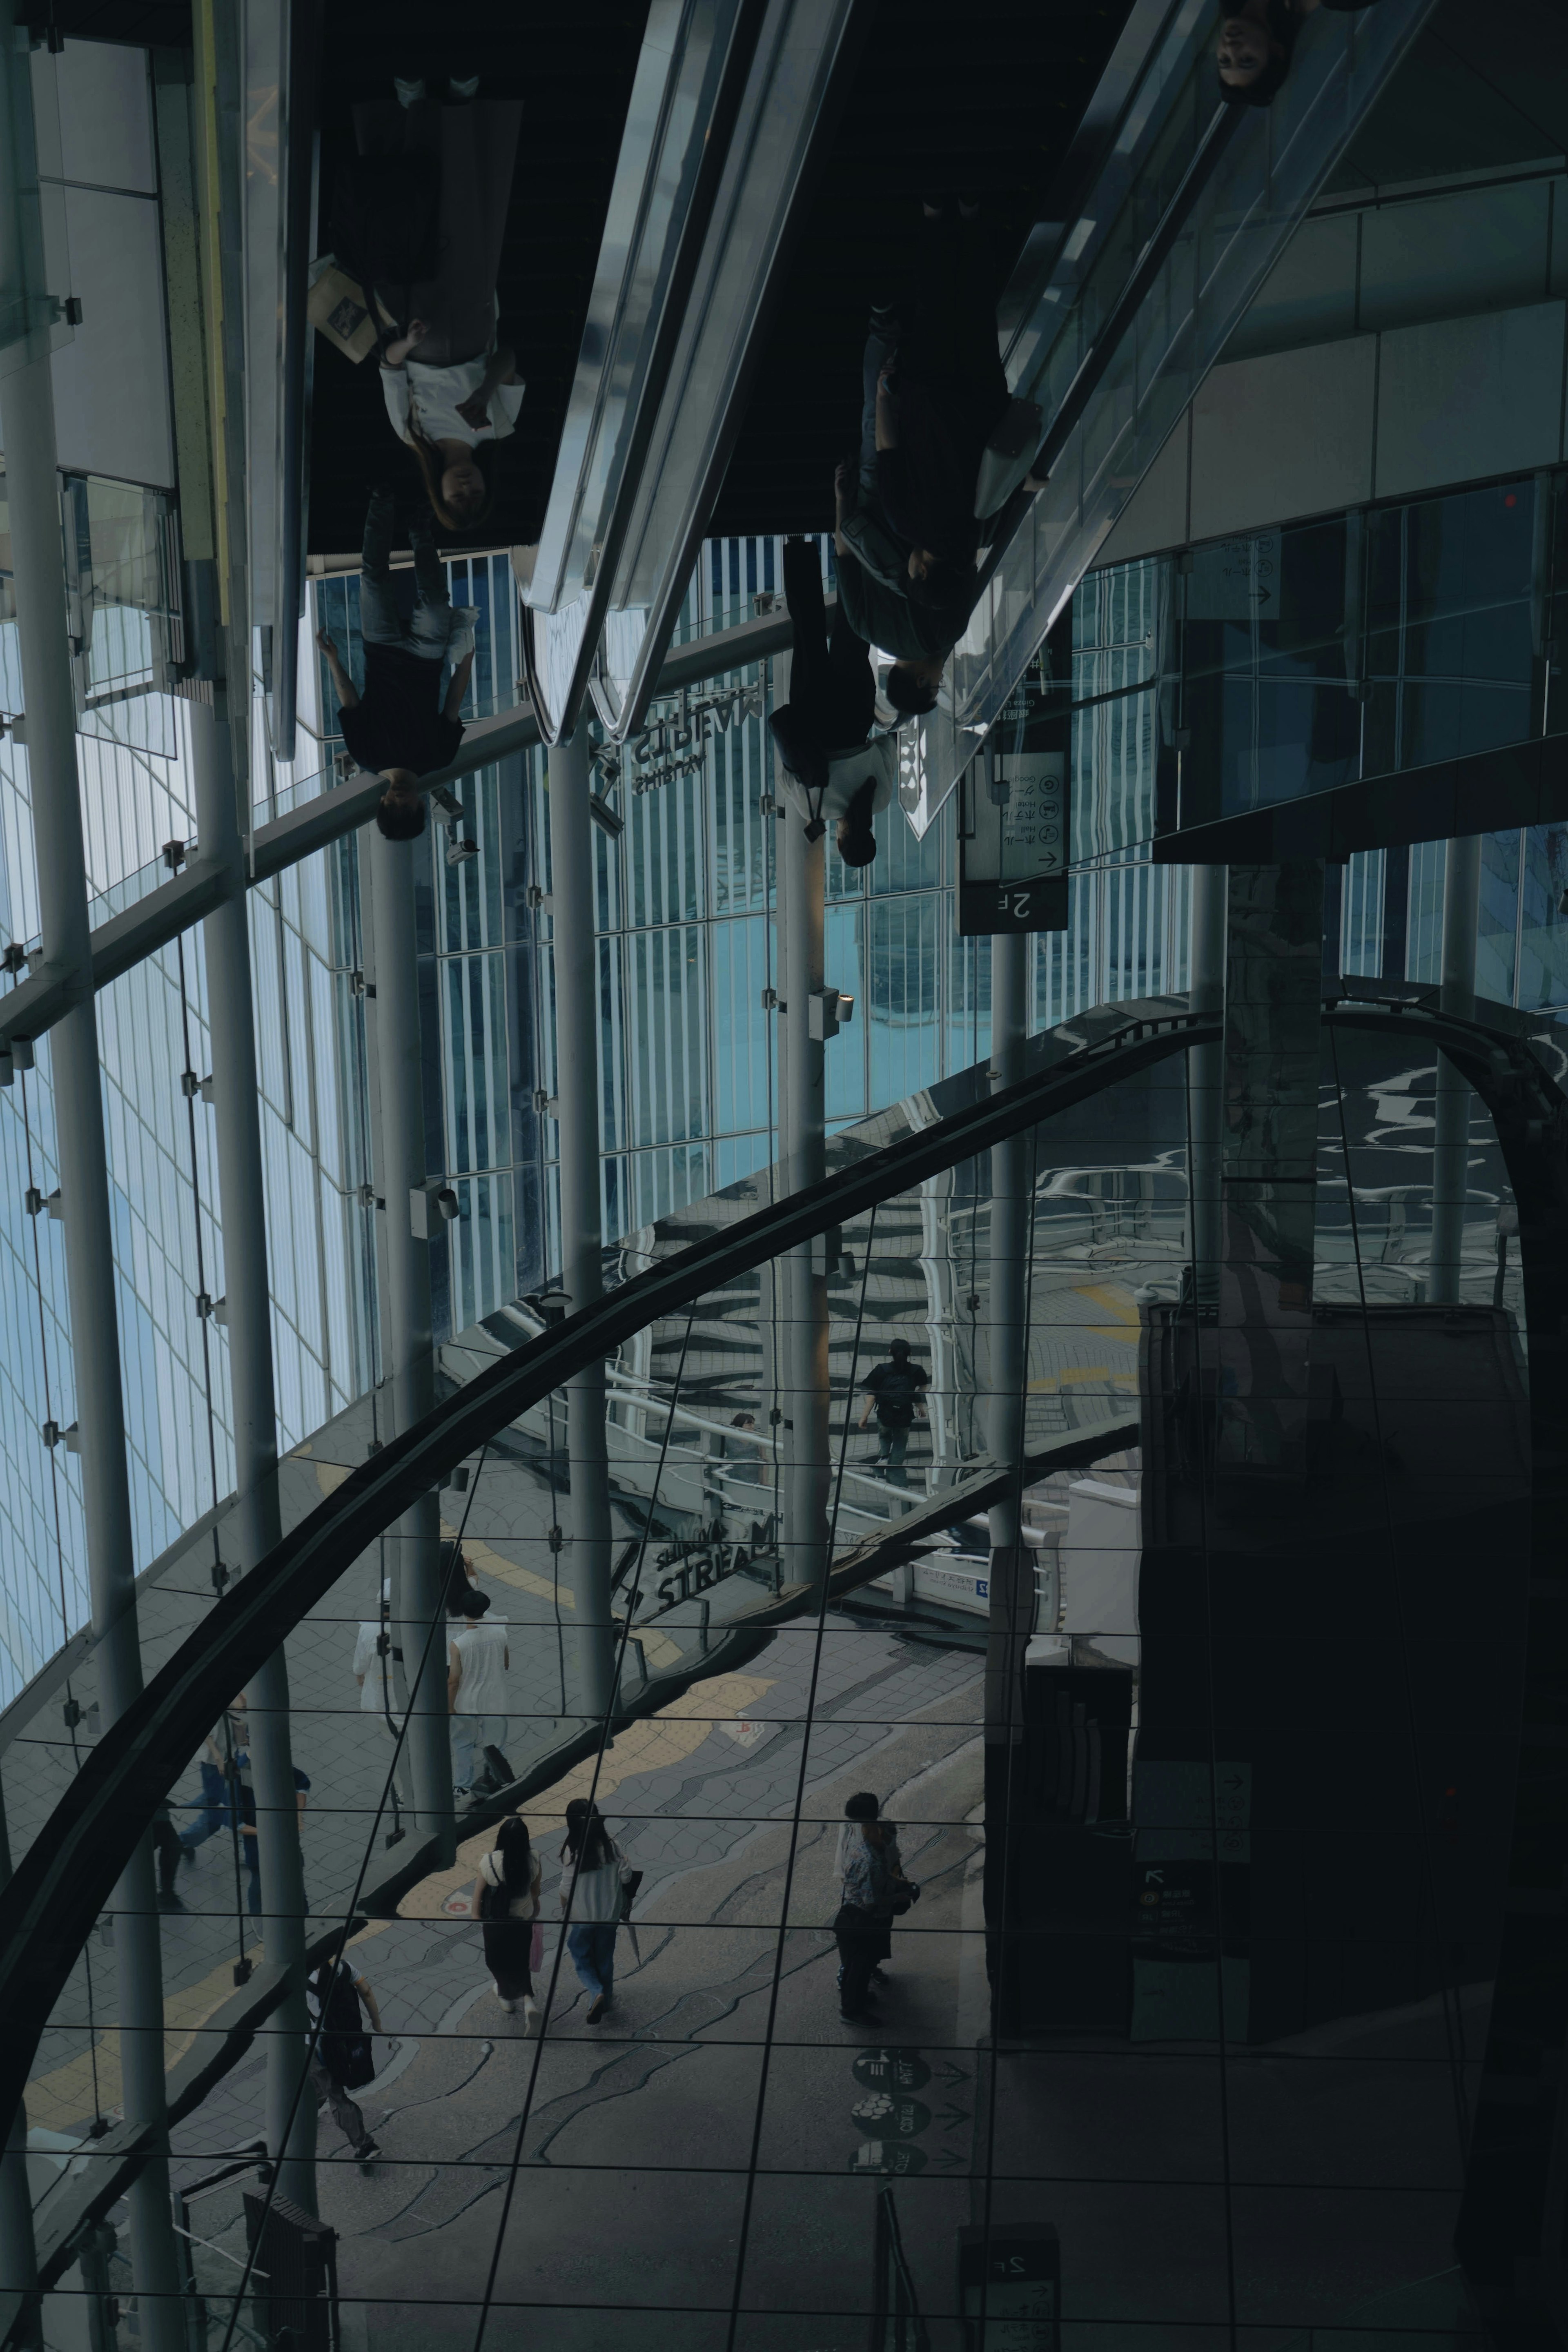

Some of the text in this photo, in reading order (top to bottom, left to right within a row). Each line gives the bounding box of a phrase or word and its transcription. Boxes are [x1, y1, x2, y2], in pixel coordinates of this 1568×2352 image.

[1220, 543, 1251, 552] ホテル
[1222, 568, 1251, 577] ホール
[1002, 810, 1036, 820] ホテル
[1004, 834, 1036, 845] ホール
[998, 893, 1030, 918] 2F
[655, 1513, 775, 1605] STREAM
